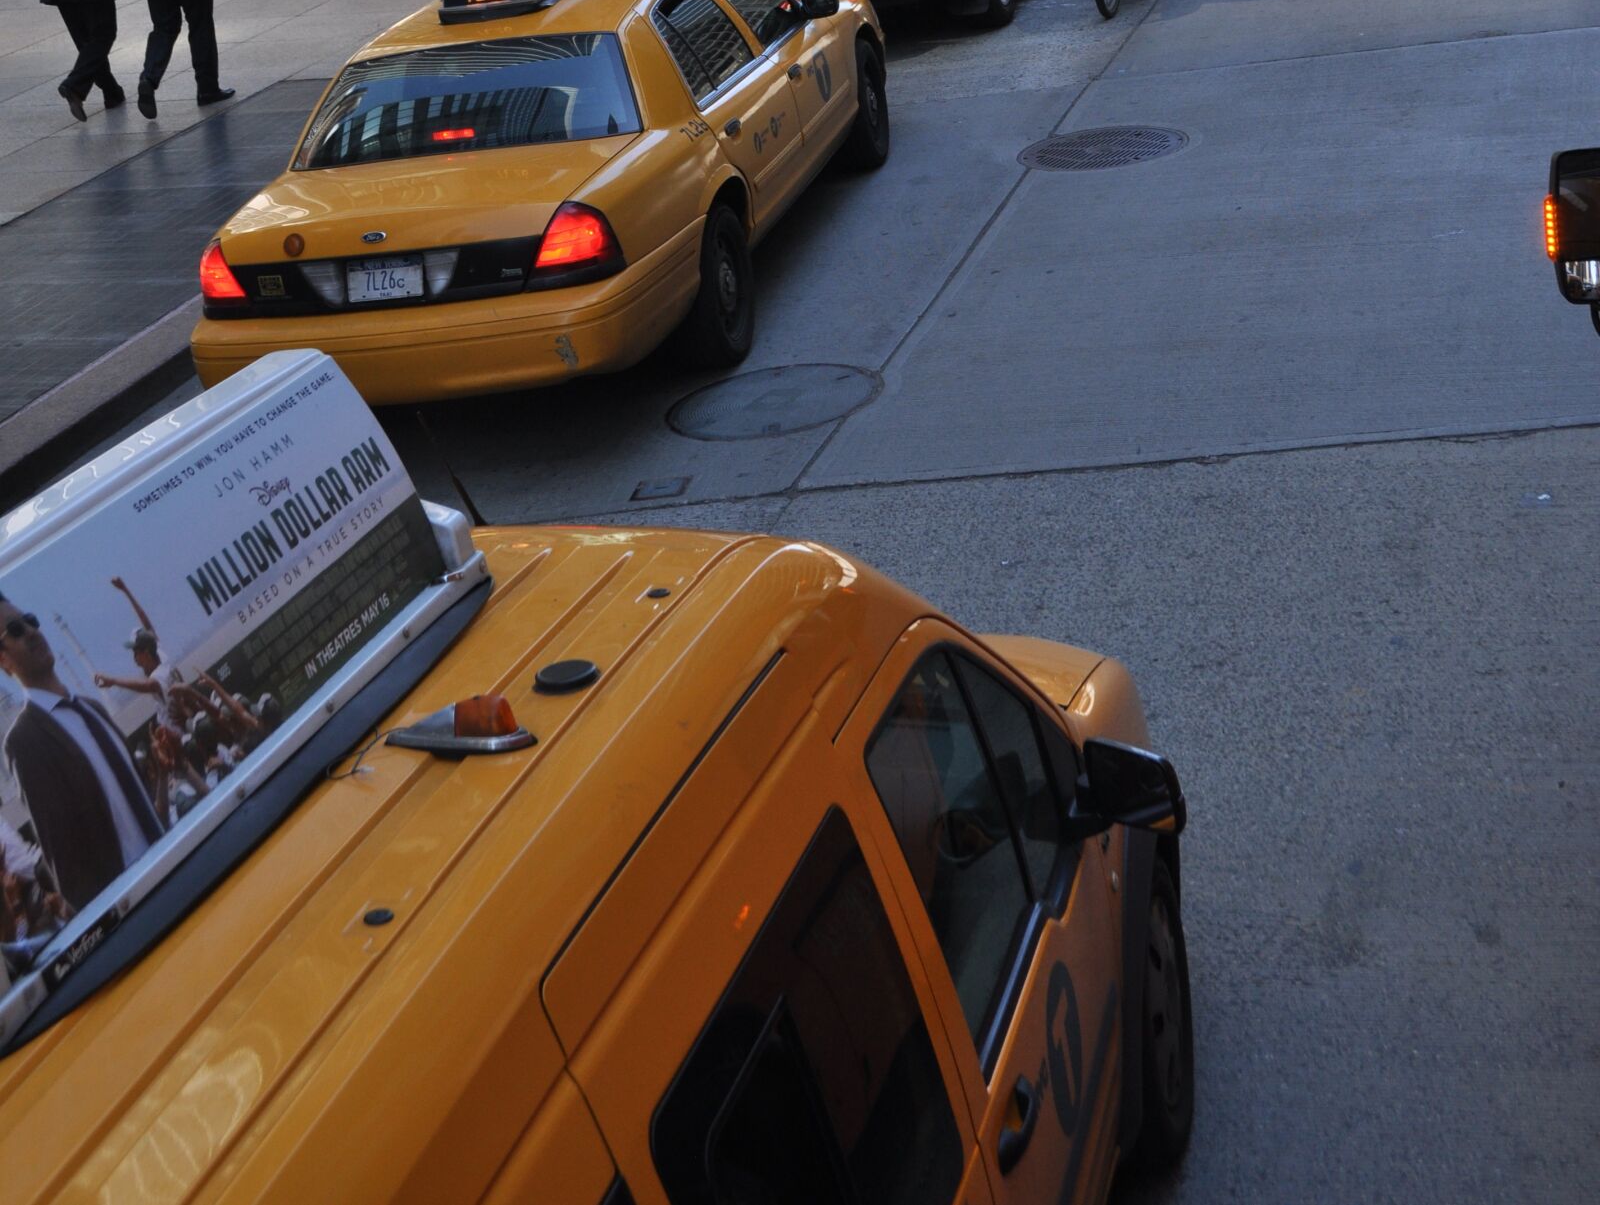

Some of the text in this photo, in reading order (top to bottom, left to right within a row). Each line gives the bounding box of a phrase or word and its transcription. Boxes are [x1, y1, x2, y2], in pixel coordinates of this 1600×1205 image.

[133, 371, 335, 514] SOMETIMES TO WIN, YOU HAVE TO CHANGE THE GAME.
[213, 433, 295, 499] JON HAMM
[186, 519, 284, 617] MILLION
[270, 466, 353, 550] DOLLAR
[341, 436, 391, 495] ARM
[237, 583, 280, 624] BASED
[284, 567, 303, 585] ON
[306, 555, 315, 567] A
[317, 527, 348, 558] TRUE
[350, 496, 385, 531] STORY
[304, 592, 391, 680] IN THEATRES MAY 16
